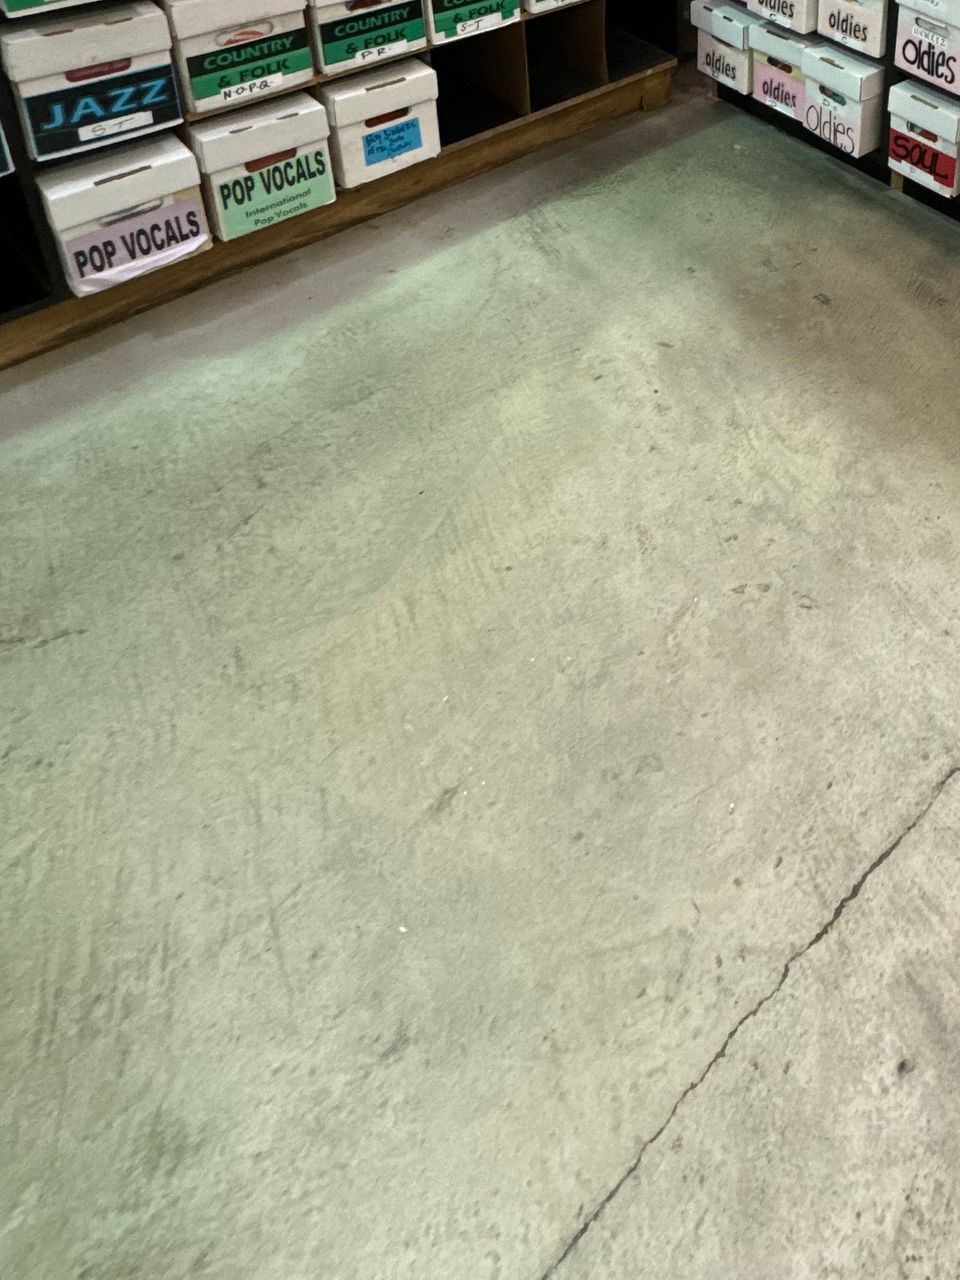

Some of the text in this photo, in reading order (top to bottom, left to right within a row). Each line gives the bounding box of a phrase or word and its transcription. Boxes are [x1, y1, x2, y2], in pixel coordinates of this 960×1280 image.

[334, 8, 410, 38] COUNTRY
[829, 10, 868, 42] oldies
[203, 36, 294, 68] COUNTRY
[902, 38, 956, 84] Oldies
[41, 79, 169, 131] JAZZ
[806, 104, 855, 154] Oldies
[219, 150, 326, 210] POP VOCALS
[245, 188, 312, 219] International
[253, 202, 308, 227] Pop Vocals
[74, 210, 201, 279] POP VOCALS
